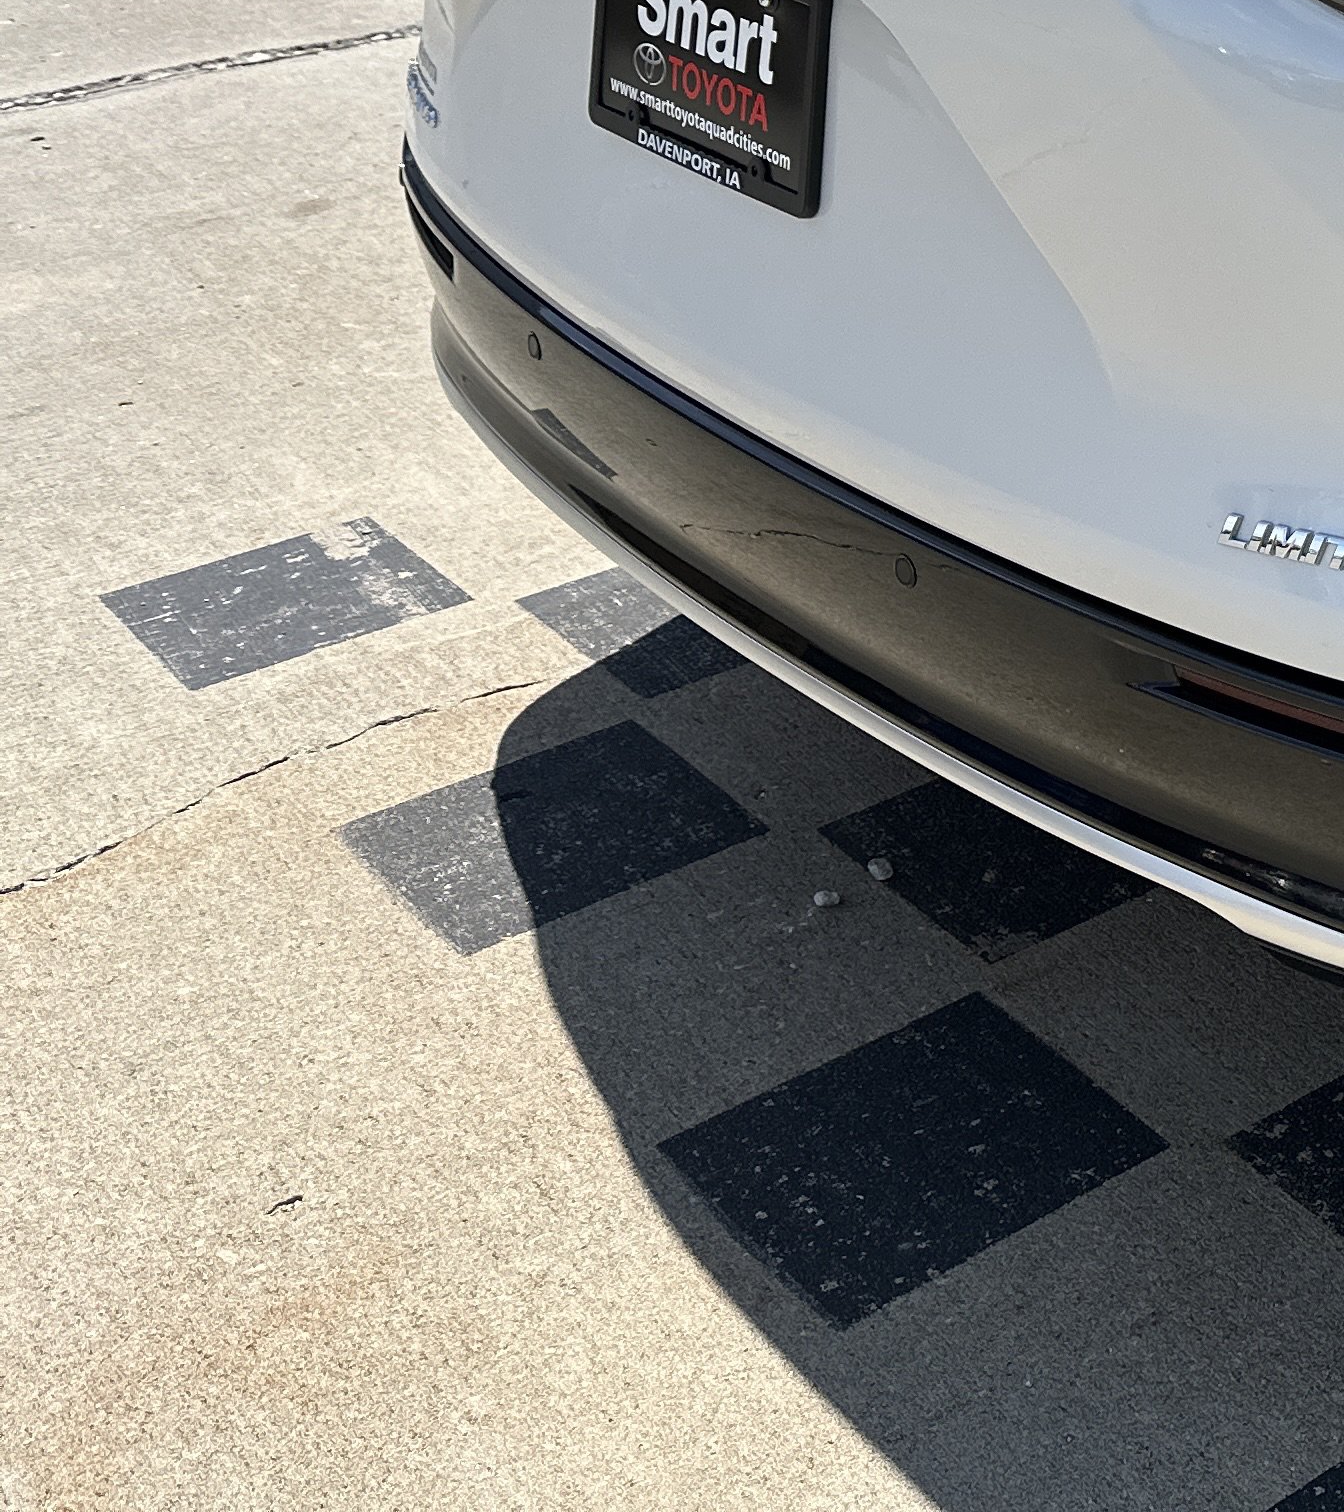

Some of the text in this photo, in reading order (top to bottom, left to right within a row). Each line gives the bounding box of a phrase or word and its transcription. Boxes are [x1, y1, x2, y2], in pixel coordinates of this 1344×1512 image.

[609, 76, 791, 171] www.smarttoyotaquadcities.com
[668, 54, 769, 133] TOYOTA
[637, 128, 742, 190] DAVENPORT, IA
